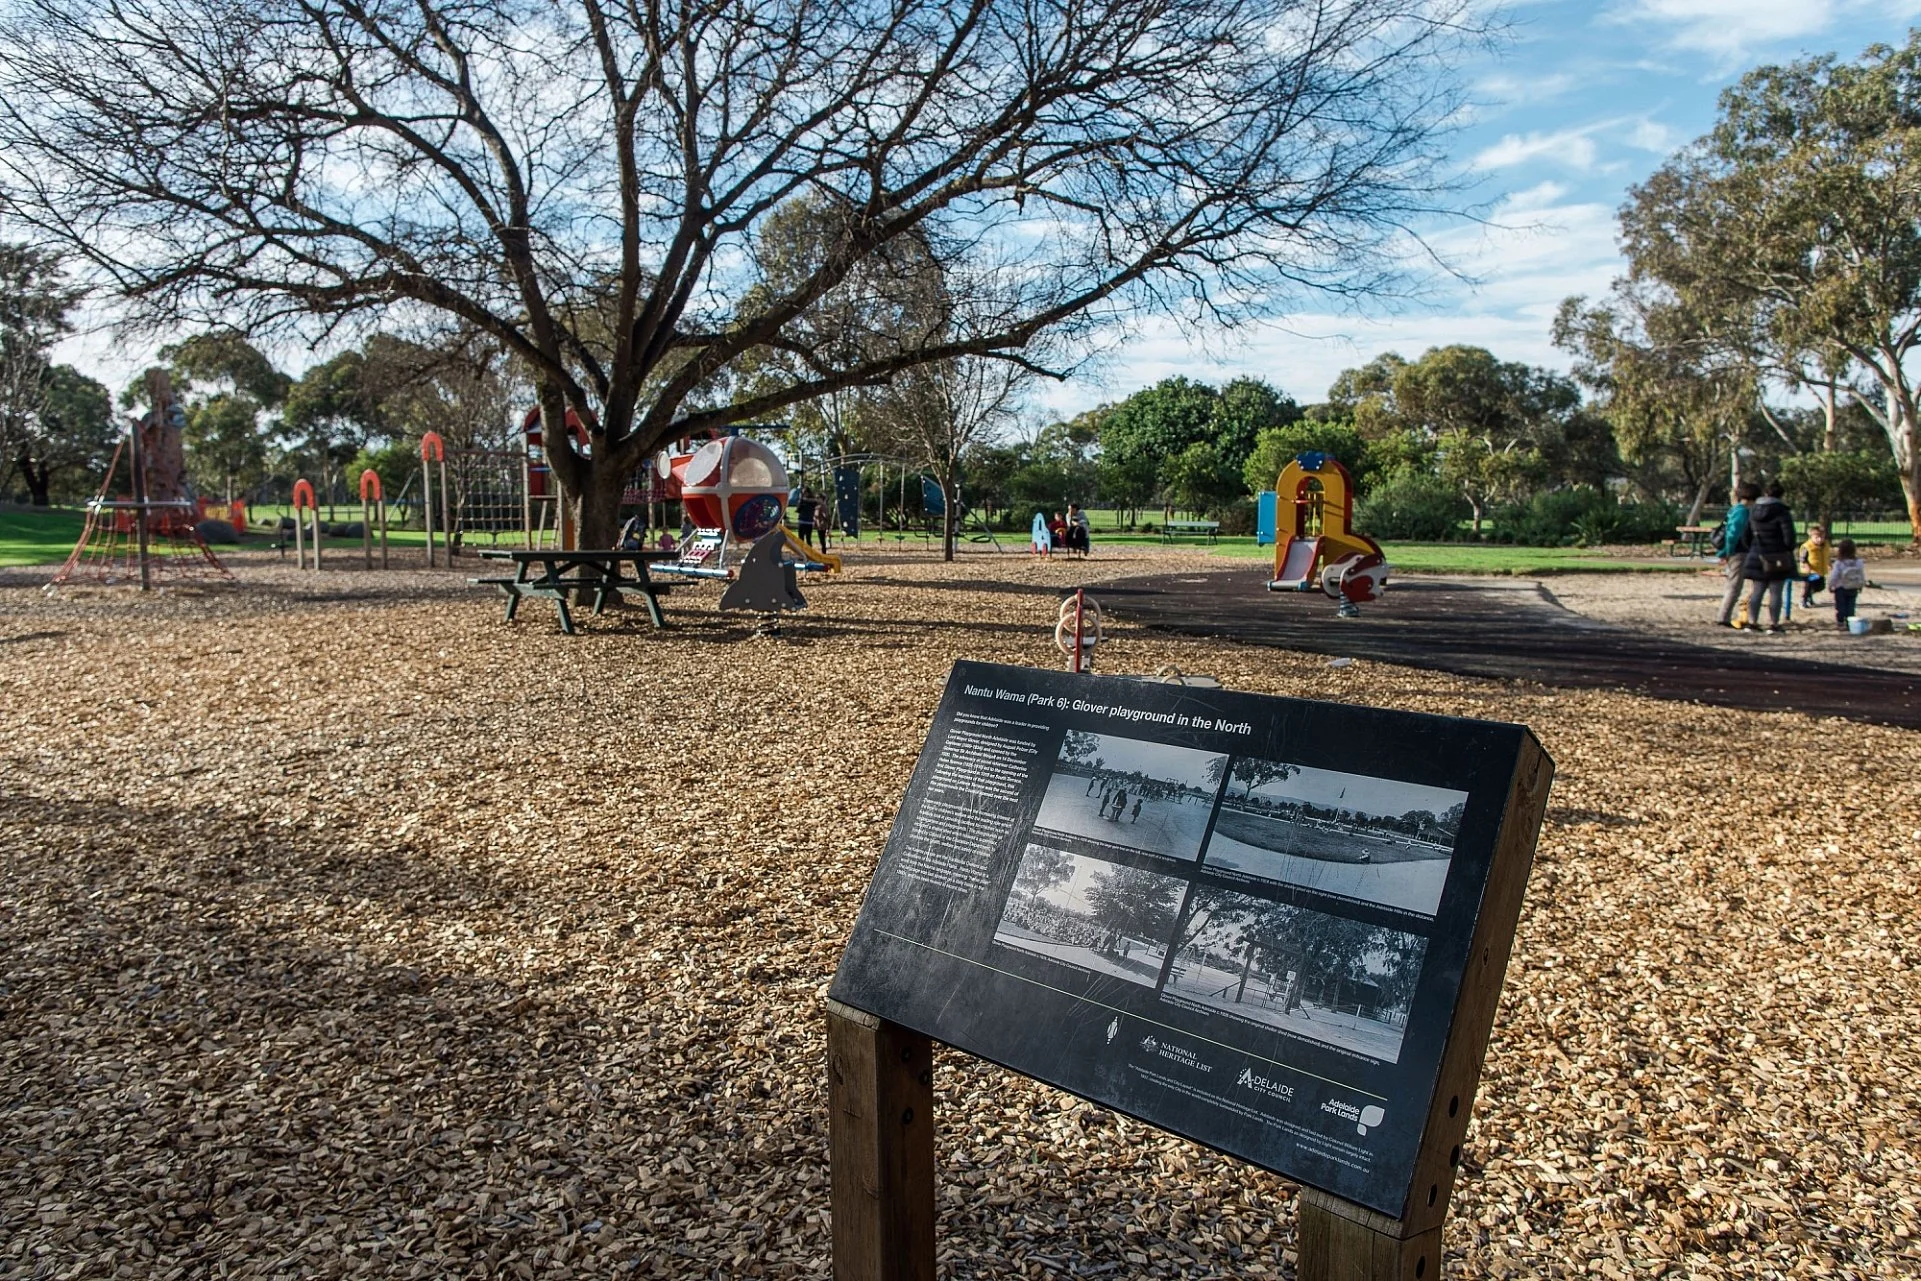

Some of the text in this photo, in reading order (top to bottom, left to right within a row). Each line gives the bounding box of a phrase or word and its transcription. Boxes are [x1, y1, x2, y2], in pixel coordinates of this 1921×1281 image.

[963, 684, 1253, 733] Nantu Wama (Park 6): Glover playground in the North
[1158, 1049, 1212, 1073] HERITAGE LIST
[1160, 1042, 1198, 1059] NATIONAL
[1237, 1067, 1294, 1096] ADELAIDE
[1267, 1091, 1291, 1102] COUNCIL
[1328, 1098, 1360, 1114] Adelaide
[1320, 1102, 1358, 1121] Park Lands
[1295, 1142, 1369, 1173] www.adelaideparklands.com.au
